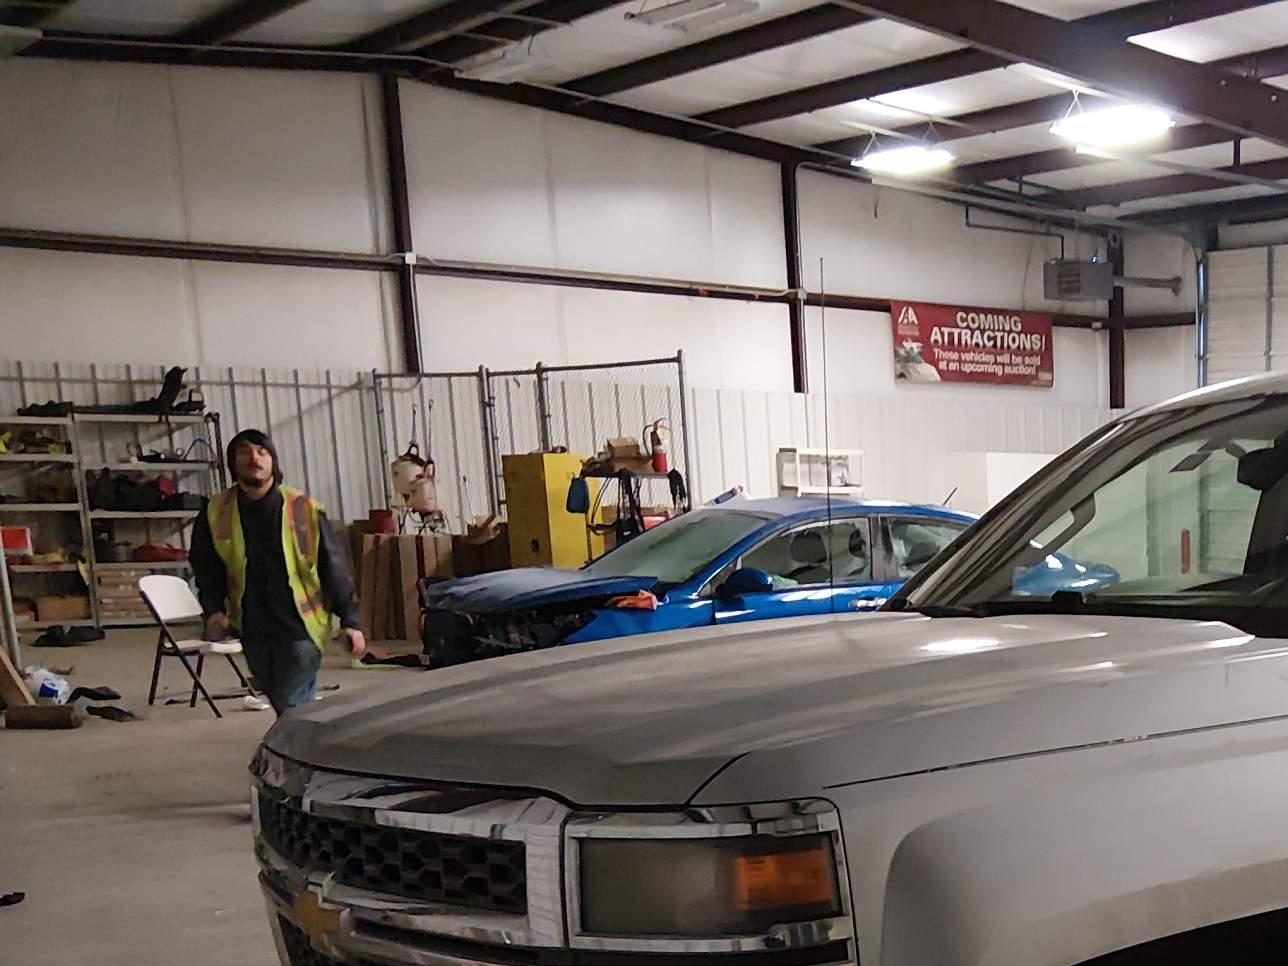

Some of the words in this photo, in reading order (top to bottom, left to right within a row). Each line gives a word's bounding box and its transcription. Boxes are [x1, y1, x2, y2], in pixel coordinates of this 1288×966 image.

[956, 311, 1022, 332] COMING
[930, 326, 1046, 352] ATTRACTIONS!
[933, 348, 959, 360] These
[961, 351, 995, 364] vehicles
[996, 352, 1010, 363] will
[1011, 354, 1022, 364] be
[1024, 355, 1041, 366] sold
[938, 361, 947, 370] at
[948, 362, 960, 371] an
[961, 362, 1003, 376] upcoming
[1004, 364, 1037, 376] auction!
